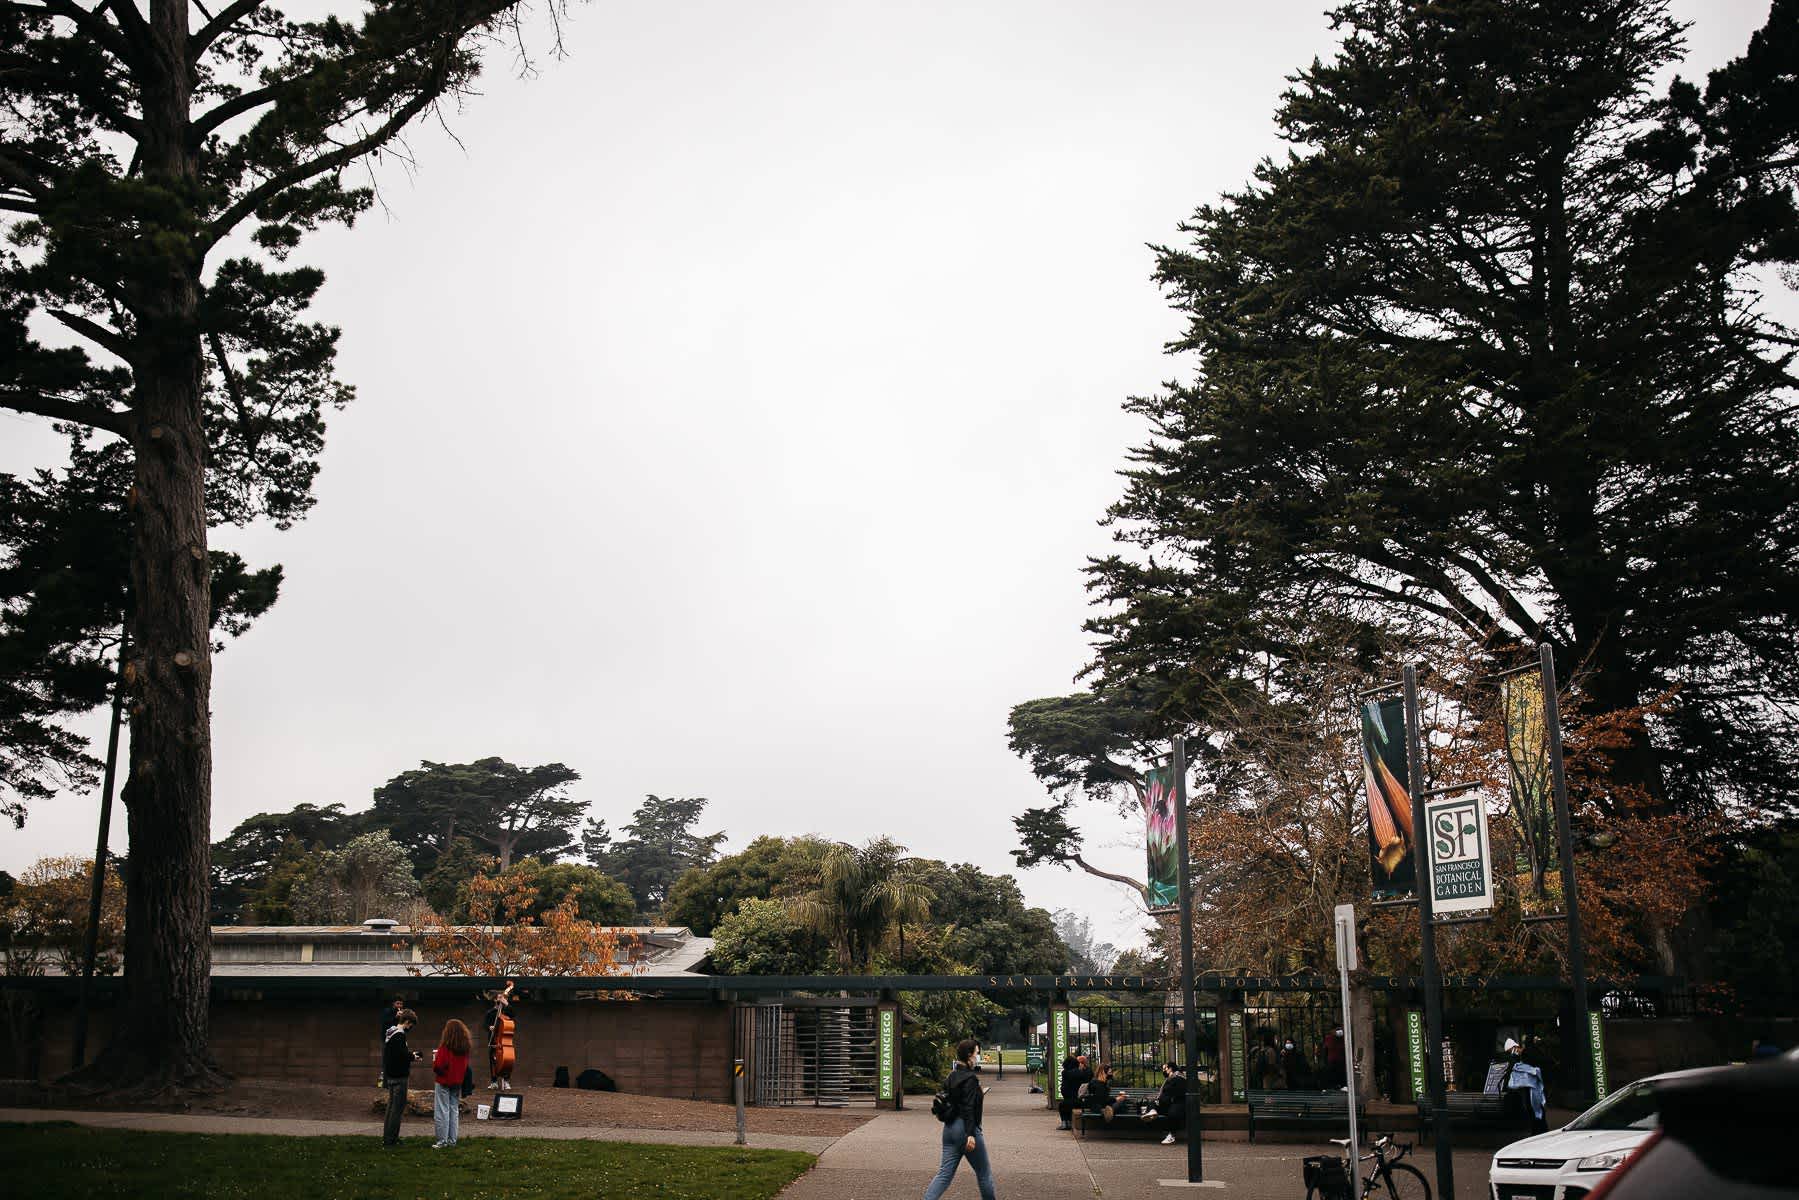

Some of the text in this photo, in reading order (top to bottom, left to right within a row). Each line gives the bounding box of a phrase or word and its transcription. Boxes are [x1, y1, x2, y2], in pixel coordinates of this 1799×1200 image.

[1435, 861, 1480, 873] SAN FRANCISCO
[1436, 871, 1481, 884] BOTANICAL
[1436, 882, 1482, 896] GARDEN
[990, 977, 1032, 987] SAN
[1055, 977, 1185, 987] FRANCIS
[1388, 977, 1488, 987] GADEN
[1056, 1012, 1065, 1048] GARDEN
[883, 1013, 891, 1097] SAN FRANCISCO
[1410, 1013, 1421, 1073] FRANCISCO
[1590, 1013, 1606, 1100] BOTANICAL GARDEN
